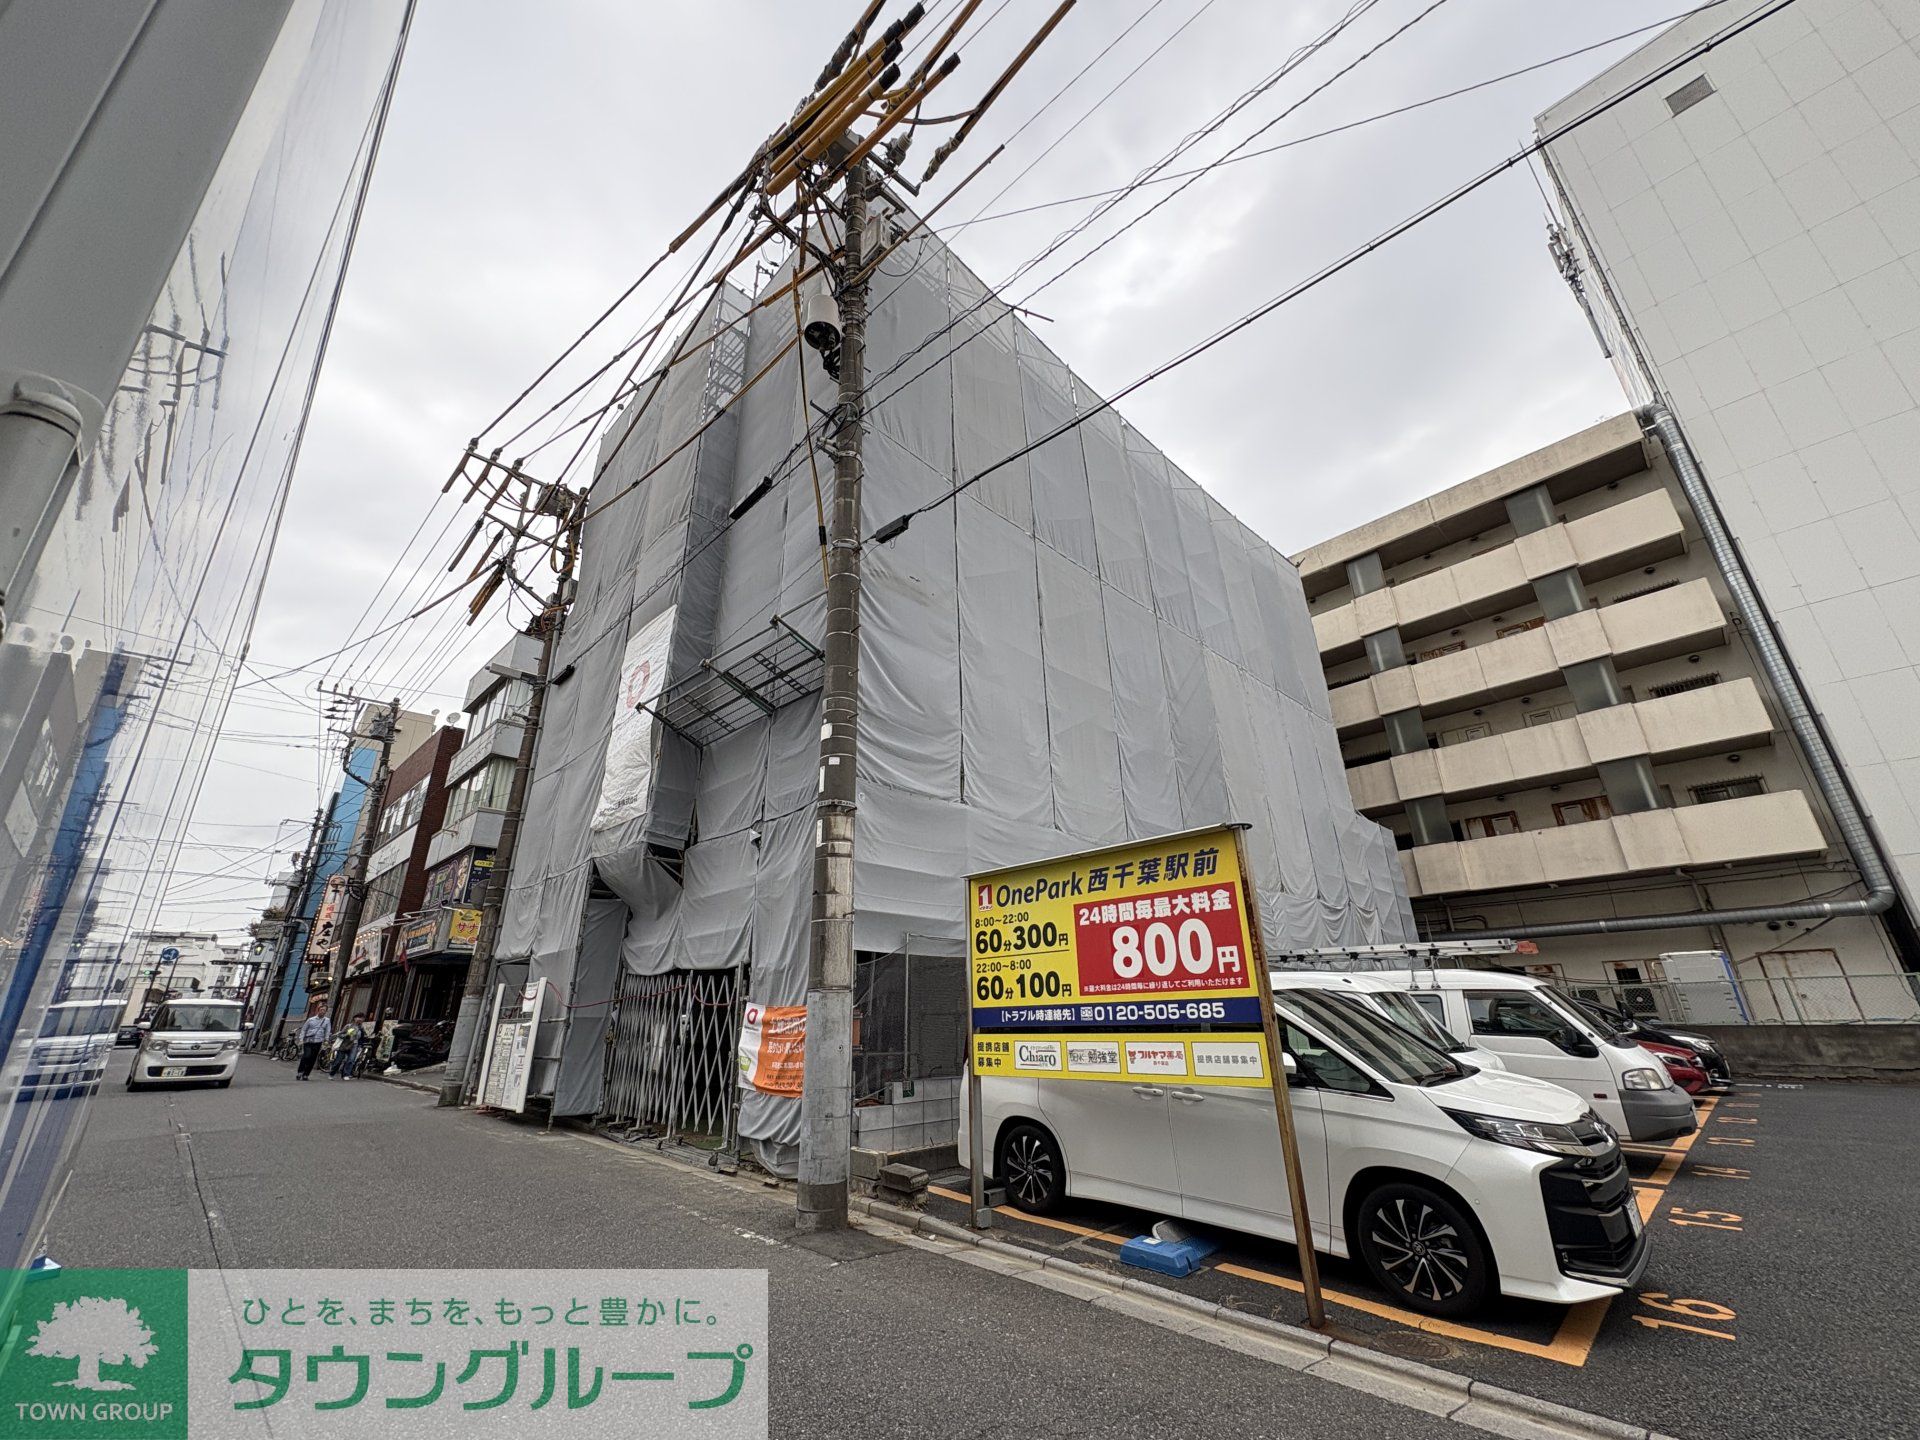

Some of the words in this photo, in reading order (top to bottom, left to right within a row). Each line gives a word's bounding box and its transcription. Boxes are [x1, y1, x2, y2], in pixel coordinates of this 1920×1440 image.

[996, 871, 1083, 908] OnePark
[1088, 848, 1220, 894] 西千葉駅前
[1079, 889, 1232, 926] 24時間毎最大料金
[1112, 918, 1241, 979] 800円
[1094, 1002, 1225, 1021] 0120-505-685
[977, 1041, 1010, 1053] 提携店舗
[1019, 1045, 1056, 1067] Chiaro
[977, 1057, 1002, 1068] 募集中
[1692, 1164, 1751, 1180] 14
[1668, 1206, 1744, 1232] 15
[1632, 1292, 1737, 1341] 16
